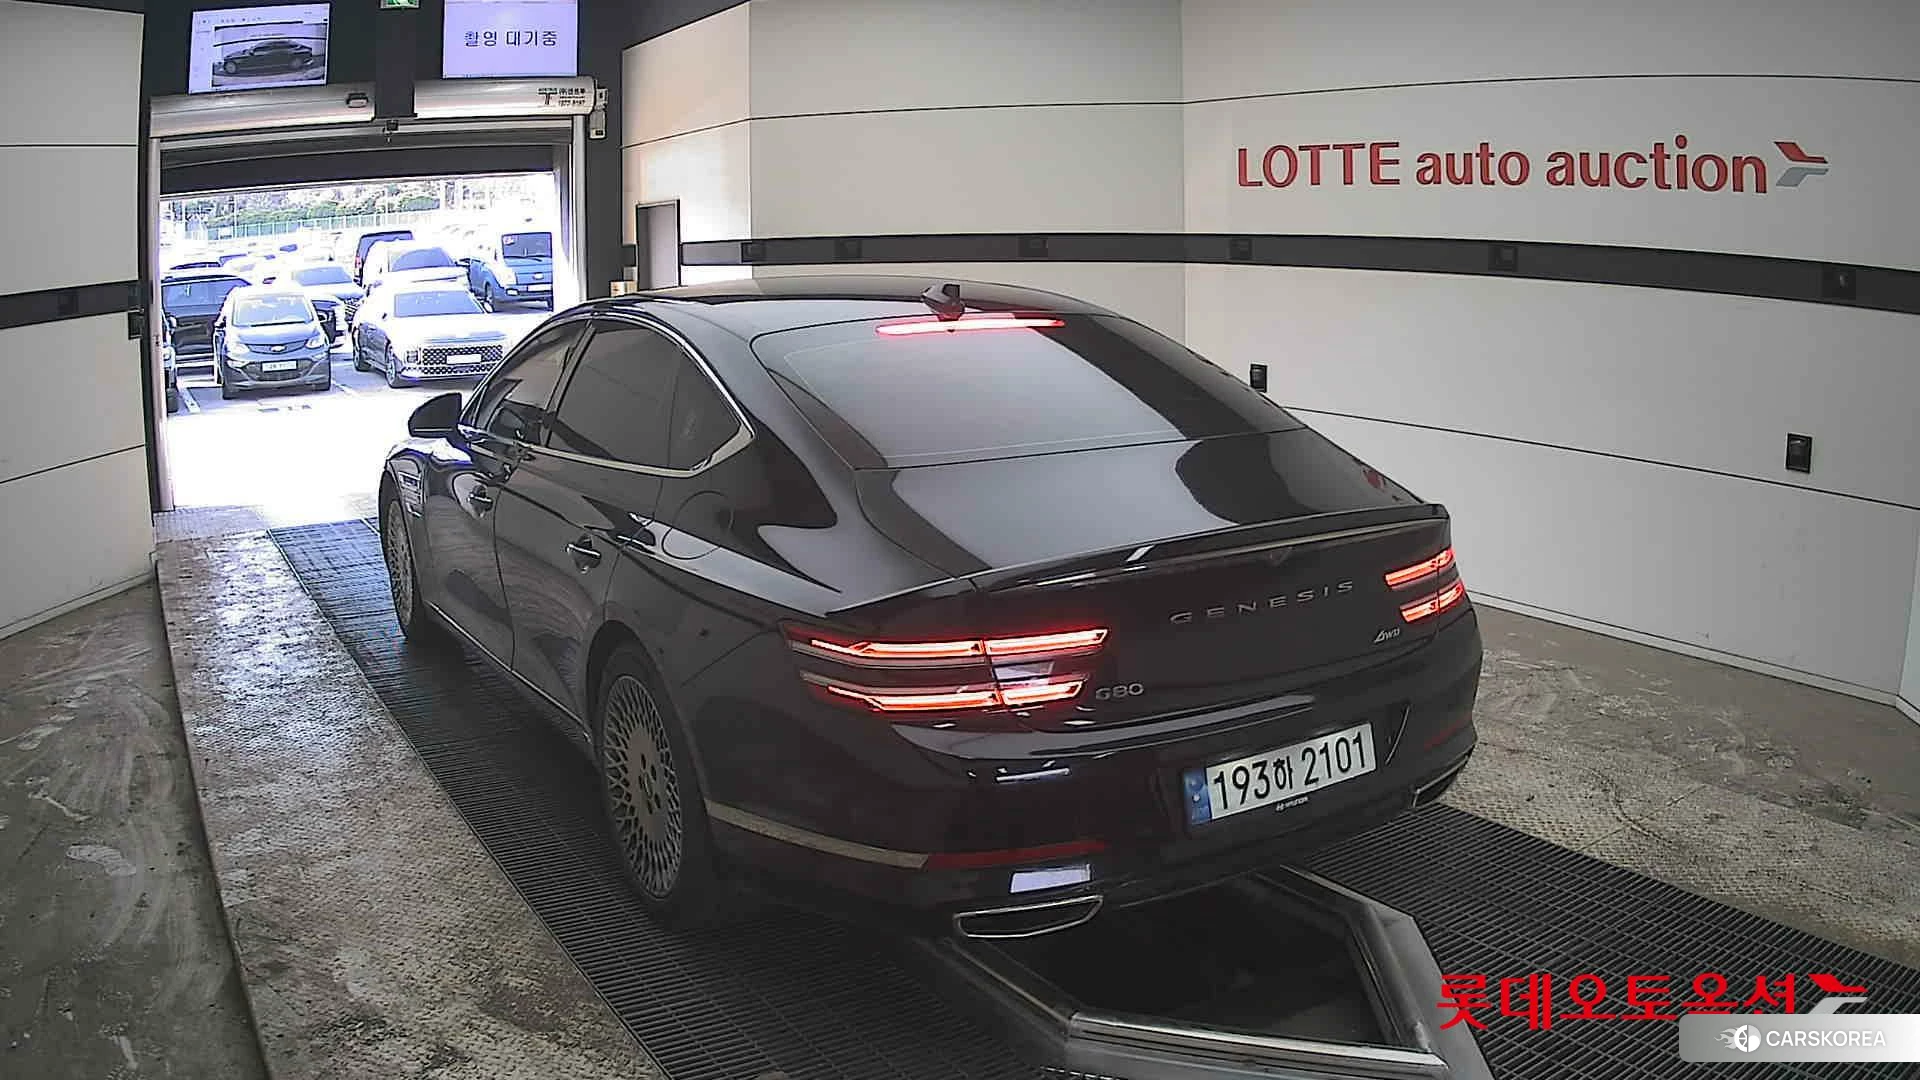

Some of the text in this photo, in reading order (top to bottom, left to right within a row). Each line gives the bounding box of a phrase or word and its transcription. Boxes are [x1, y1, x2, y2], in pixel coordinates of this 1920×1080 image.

[506, 30, 557, 47] 대기중
[1236, 135, 1768, 194] LOTTE auto auction
[1169, 580, 1354, 625] GENESIS
[1094, 682, 1145, 702] G80
[1213, 731, 1366, 810] 193하 2101
